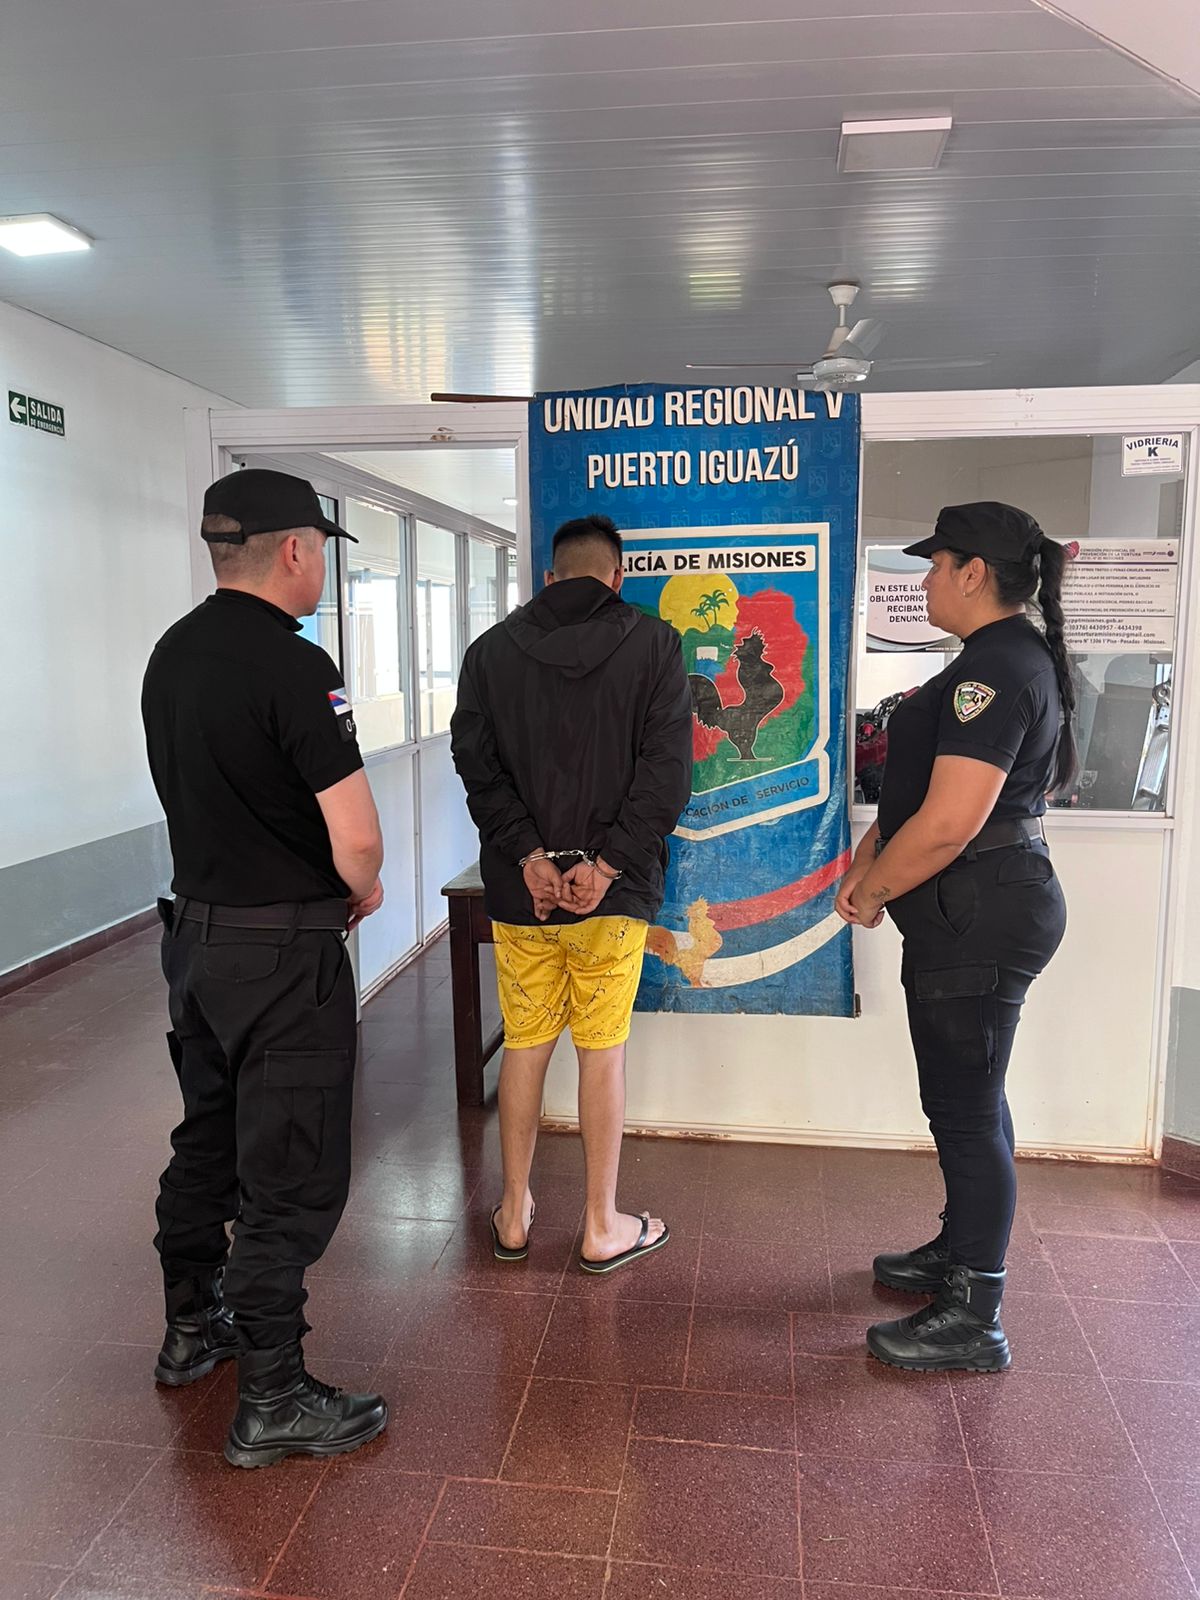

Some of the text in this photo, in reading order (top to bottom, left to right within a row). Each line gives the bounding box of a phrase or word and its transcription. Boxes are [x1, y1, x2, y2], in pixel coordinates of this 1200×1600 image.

[30, 401, 62, 424] SALIDA
[544, 386, 844, 433] UNIDAD REGIONAL V
[1126, 437, 1179, 450] VIDRIERIA
[1147, 446, 1158, 457] K
[588, 438, 799, 489] PUERTO IGUAZÚ
[623, 551, 807, 572] ICÍA DE MISIONES
[731, 795, 750, 807] DE
[755, 776, 810, 800] SERVICIO
